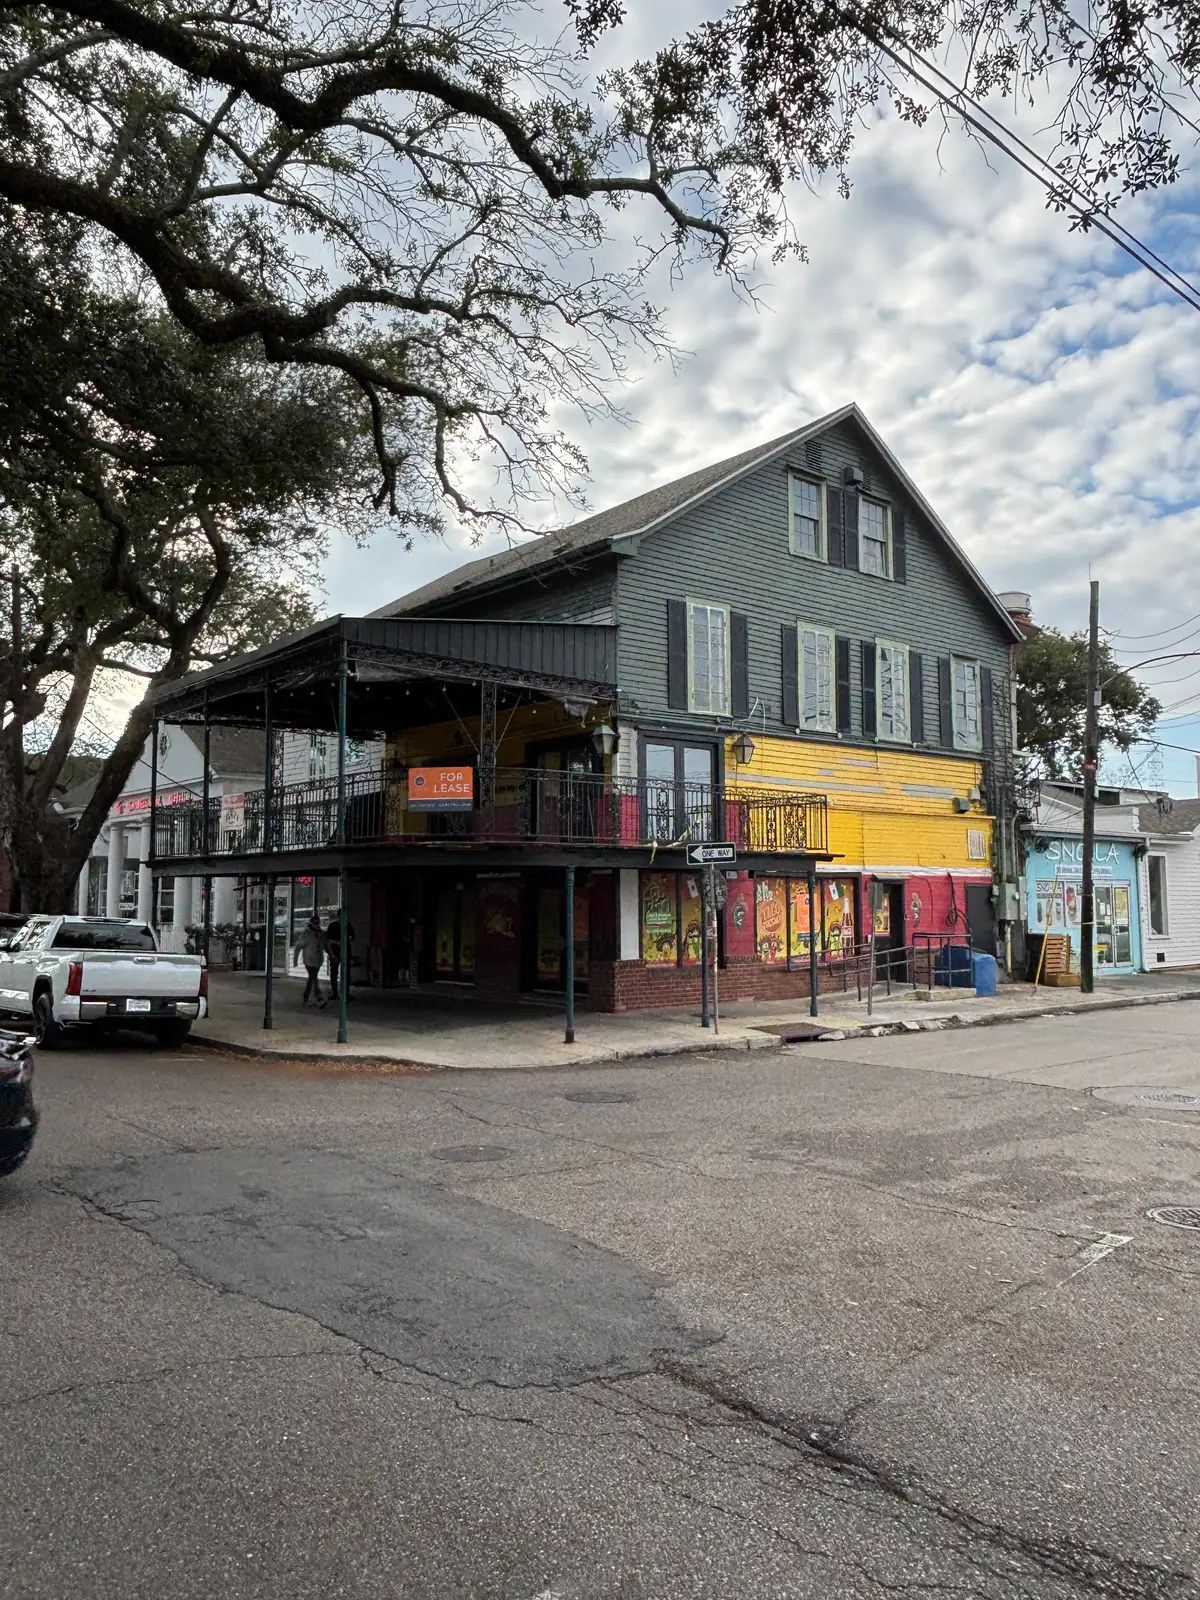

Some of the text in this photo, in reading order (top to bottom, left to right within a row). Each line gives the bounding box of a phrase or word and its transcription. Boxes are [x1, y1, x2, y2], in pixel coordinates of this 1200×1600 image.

[440, 772, 463, 782] FOR
[433, 783, 470, 793] LEASE
[701, 848, 730, 858] ONE WAY
